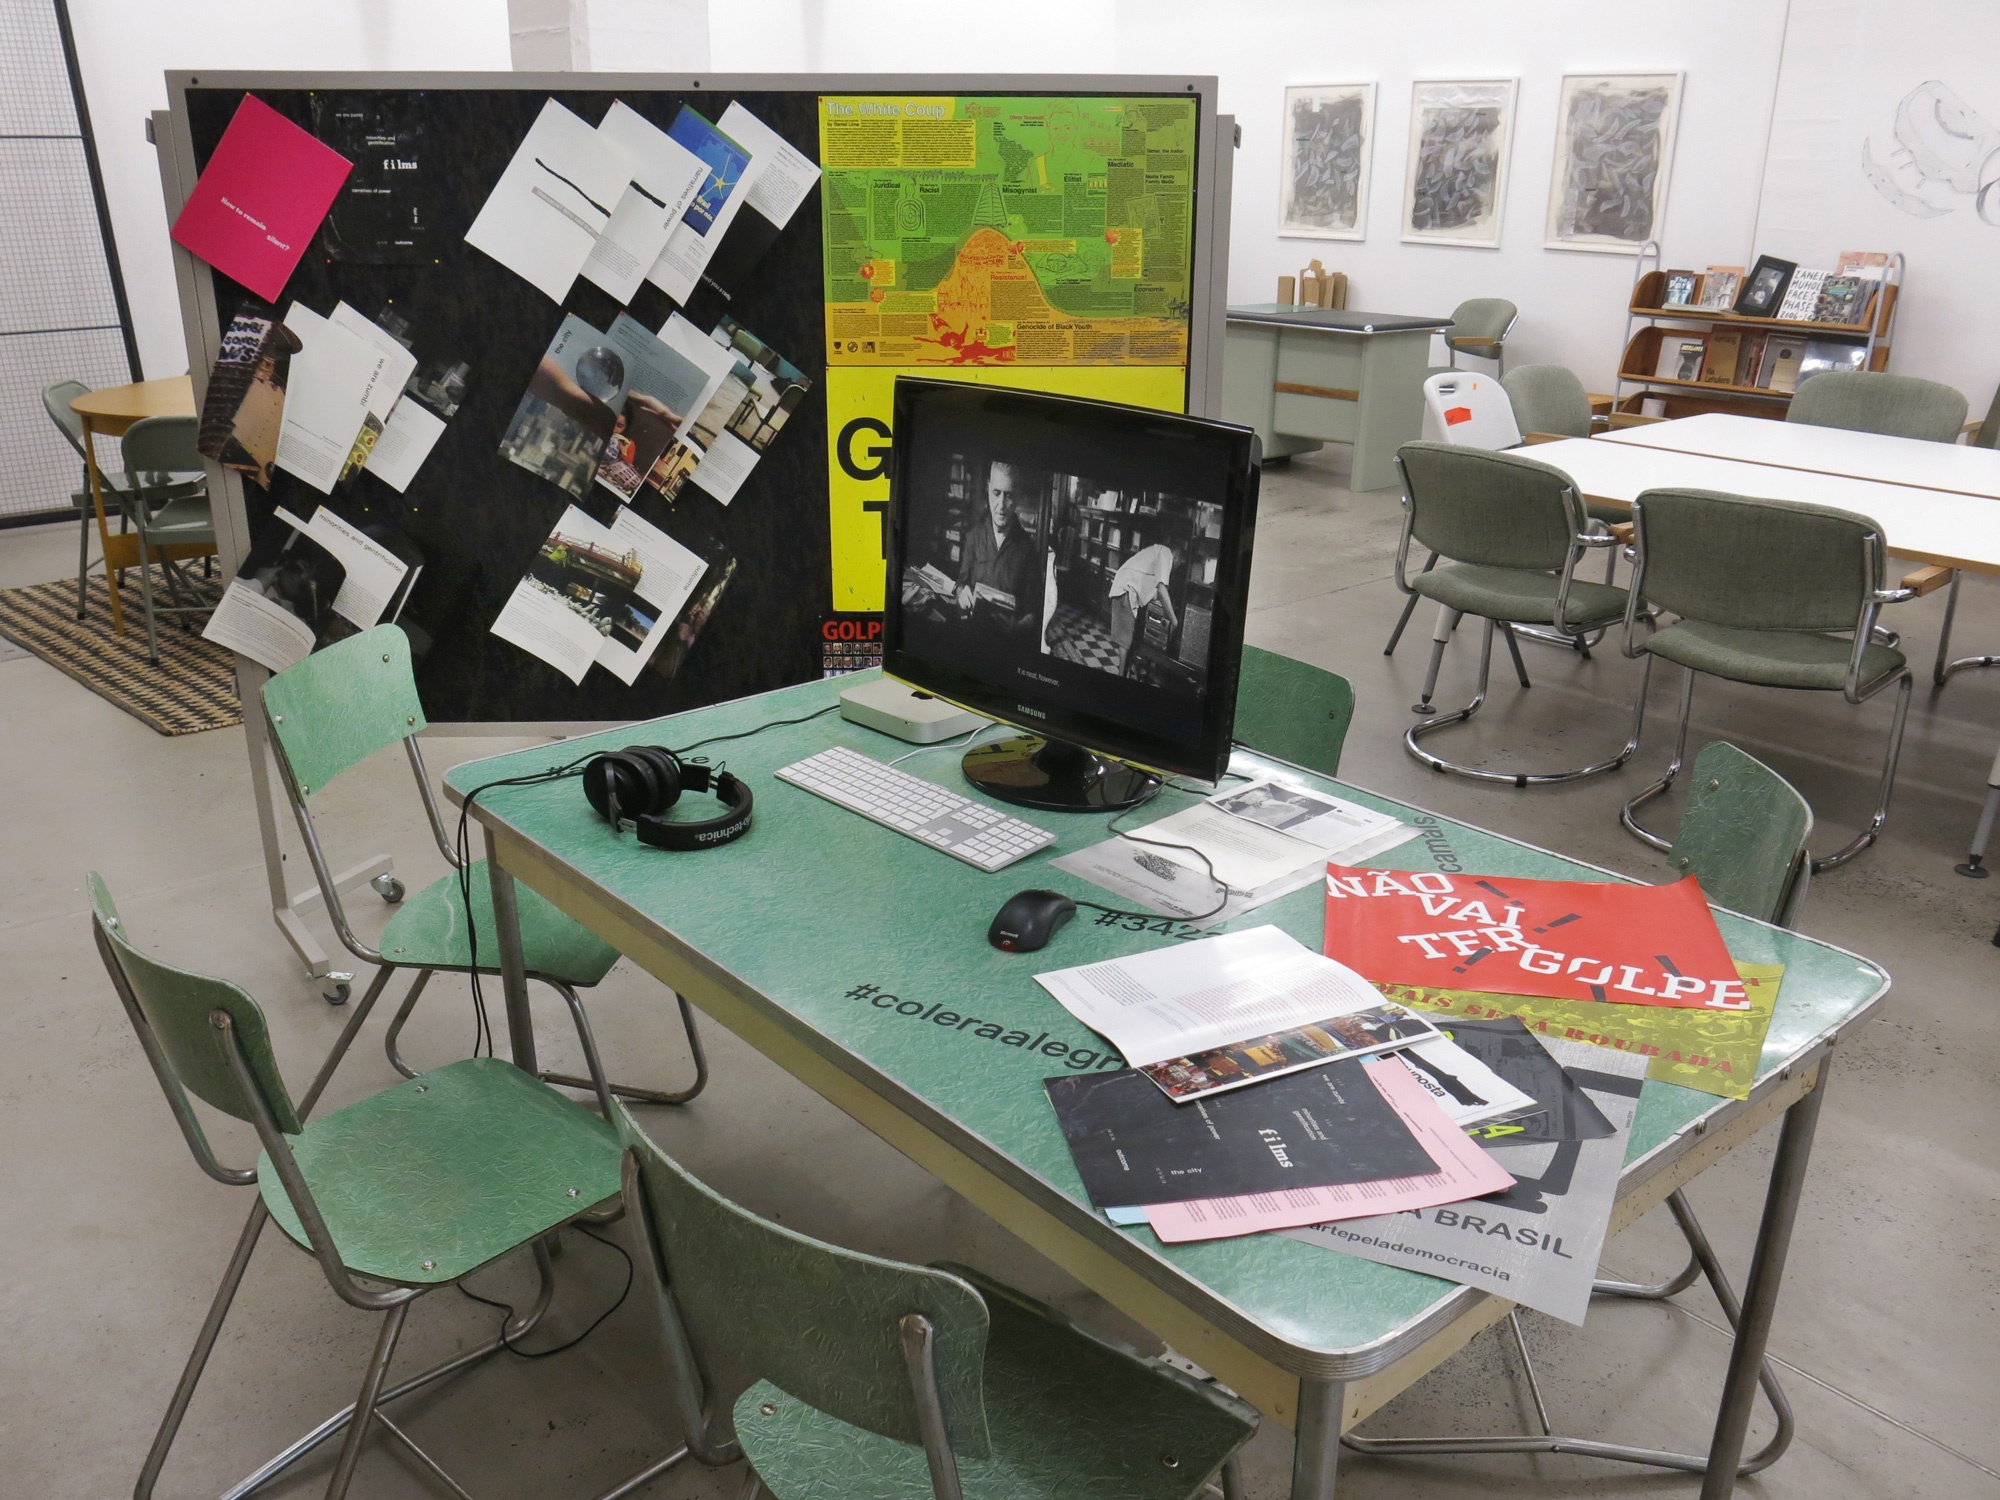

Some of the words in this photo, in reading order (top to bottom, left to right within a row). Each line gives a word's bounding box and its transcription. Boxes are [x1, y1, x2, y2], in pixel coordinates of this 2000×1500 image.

[826, 102, 854, 116] The
[858, 102, 901, 116] White
[905, 102, 946, 120] Coup
[383, 159, 418, 170] films
[681, 166, 703, 200] narratives
[1002, 187, 1038, 195] Misogynist
[675, 201, 683, 210] of
[663, 208, 678, 231] power
[1133, 285, 1166, 293] Economic
[1668, 280, 1693, 290] Park
[1783, 300, 1813, 313] PHASE
[554, 340, 566, 355] the
[562, 328, 573, 344] city
[376, 358, 385, 370] we
[370, 370, 380, 383] are
[359, 383, 374, 407] zumbi
[318, 513, 350, 538] minorities
[350, 535, 364, 546] and
[363, 543, 403, 574] gentrification
[683, 565, 702, 591] outcome
[822, 621, 884, 640] GOLP
[1017, 704, 1047, 720] SAMSUNG
[1326, 870, 1455, 898] NÃO
[1415, 892, 1525, 929] VAI
[1397, 927, 1540, 959] TER
[1519, 948, 1752, 1010] GOLPE
[1377, 983, 1453, 1008] MAIS
[1564, 1027, 1734, 1074] ROUBADA
[1322, 1073, 1330, 1082] we
[1326, 1082, 1336, 1090] are
[1332, 1090, 1347, 1105] zumbi
[1207, 1125, 1221, 1140] power
[1291, 1110, 1317, 1141] gentrification
[1302, 1107, 1320, 1131] minorities
[1316, 1130, 1329, 1141] and
[1115, 1149, 1130, 1171] outcome
[1258, 1128, 1294, 1168] films
[1186, 1167, 1203, 1175] city
[1434, 1208, 1574, 1259] BRASIL
[1308, 1222, 1511, 1282] artepelademocracia
